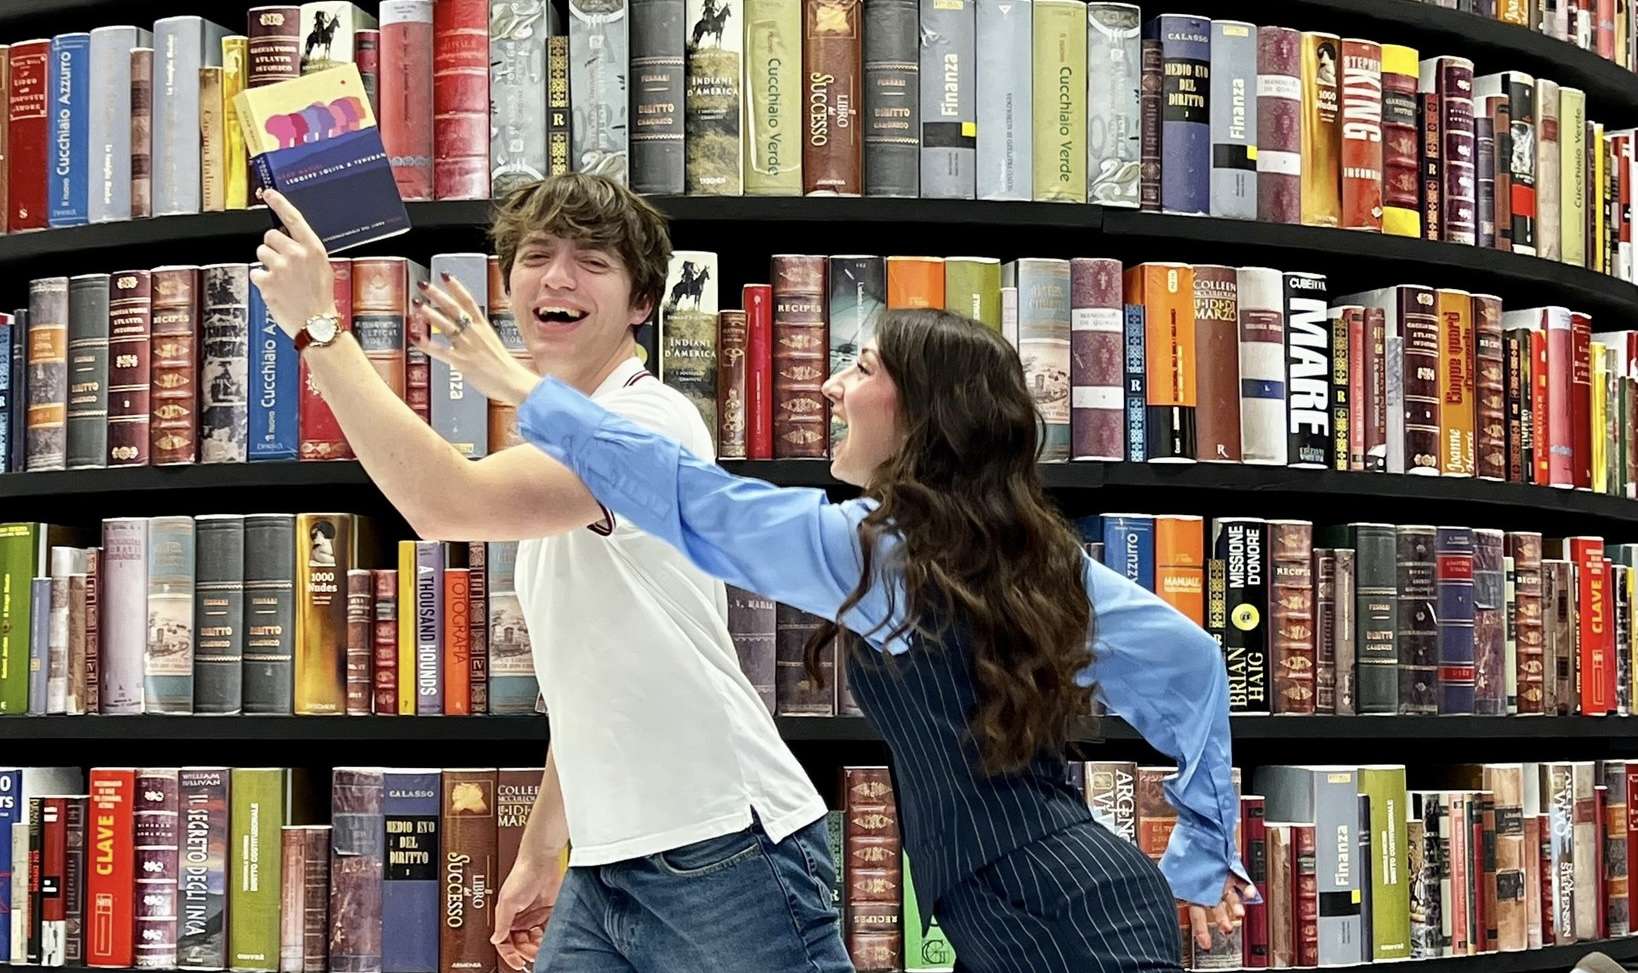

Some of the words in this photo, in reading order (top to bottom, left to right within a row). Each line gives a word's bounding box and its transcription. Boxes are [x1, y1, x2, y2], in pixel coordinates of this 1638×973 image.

[58, 50, 72, 105] Azzurro
[687, 86, 739, 97] D'AMERICA
[692, 76, 733, 86] INDIANI
[767, 57, 782, 129] Cucchiaio
[941, 53, 958, 117] Finanza
[553, 113, 565, 126] R
[810, 72, 835, 147] SUCCESSO
[836, 94, 849, 128] LIBRO
[1059, 66, 1073, 136] Cucchiaio
[1230, 78, 1245, 140] Finanza
[1344, 68, 1382, 143] KING
[56, 108, 72, 177] Cucchiaio
[1573, 107, 1583, 144] Verde
[767, 132, 783, 176] Verde
[1059, 139, 1073, 182] Verde
[1428, 163, 1436, 175] R
[1573, 145, 1583, 209] Cucchiaio
[1193, 279, 1237, 291] COLLEEN
[777, 303, 823, 314] RECIPES
[1193, 308, 1237, 322] MARZO
[664, 348, 717, 359] D'AMERICA
[669, 338, 711, 348] INDIANI
[1443, 311, 1462, 357] quarti
[260, 340, 276, 408] Cucchiaio
[1130, 379, 1142, 391] R
[1289, 297, 1329, 437] MARE
[1336, 390, 1346, 402] R
[1536, 395, 1545, 458] MACMILLAN
[1446, 427, 1461, 473] Joanne
[311, 572, 335, 582] 1000
[418, 564, 433, 576] A
[1126, 533, 1139, 583] zzurro
[1228, 524, 1245, 589] MISSIONE
[1246, 528, 1262, 586] D'ONORE
[307, 581, 338, 593] Nudes
[1591, 579, 1603, 634] CLAVE
[418, 576, 436, 642] THOUSAND
[420, 644, 438, 697] HOUNDS
[1227, 646, 1248, 708] BRIAN
[1247, 651, 1264, 703] HAIG
[182, 772, 220, 780] WILLIAM
[389, 790, 434, 798] CALASSO
[187, 793, 208, 810] IL
[498, 814, 528, 827] MAR
[96, 814, 115, 876] CLAVE
[187, 809, 208, 867] SEGRETO
[386, 820, 413, 833] MEDIO
[399, 836, 419, 849] DEL
[389, 851, 429, 865] DIRITTO
[1335, 824, 1349, 886] Finanza
[186, 867, 208, 901] DEGLI
[447, 852, 471, 928] SUCCESSO
[472, 874, 485, 908] LIBRO
[184, 902, 207, 937] INCA
[854, 914, 898, 924] RECIPES
